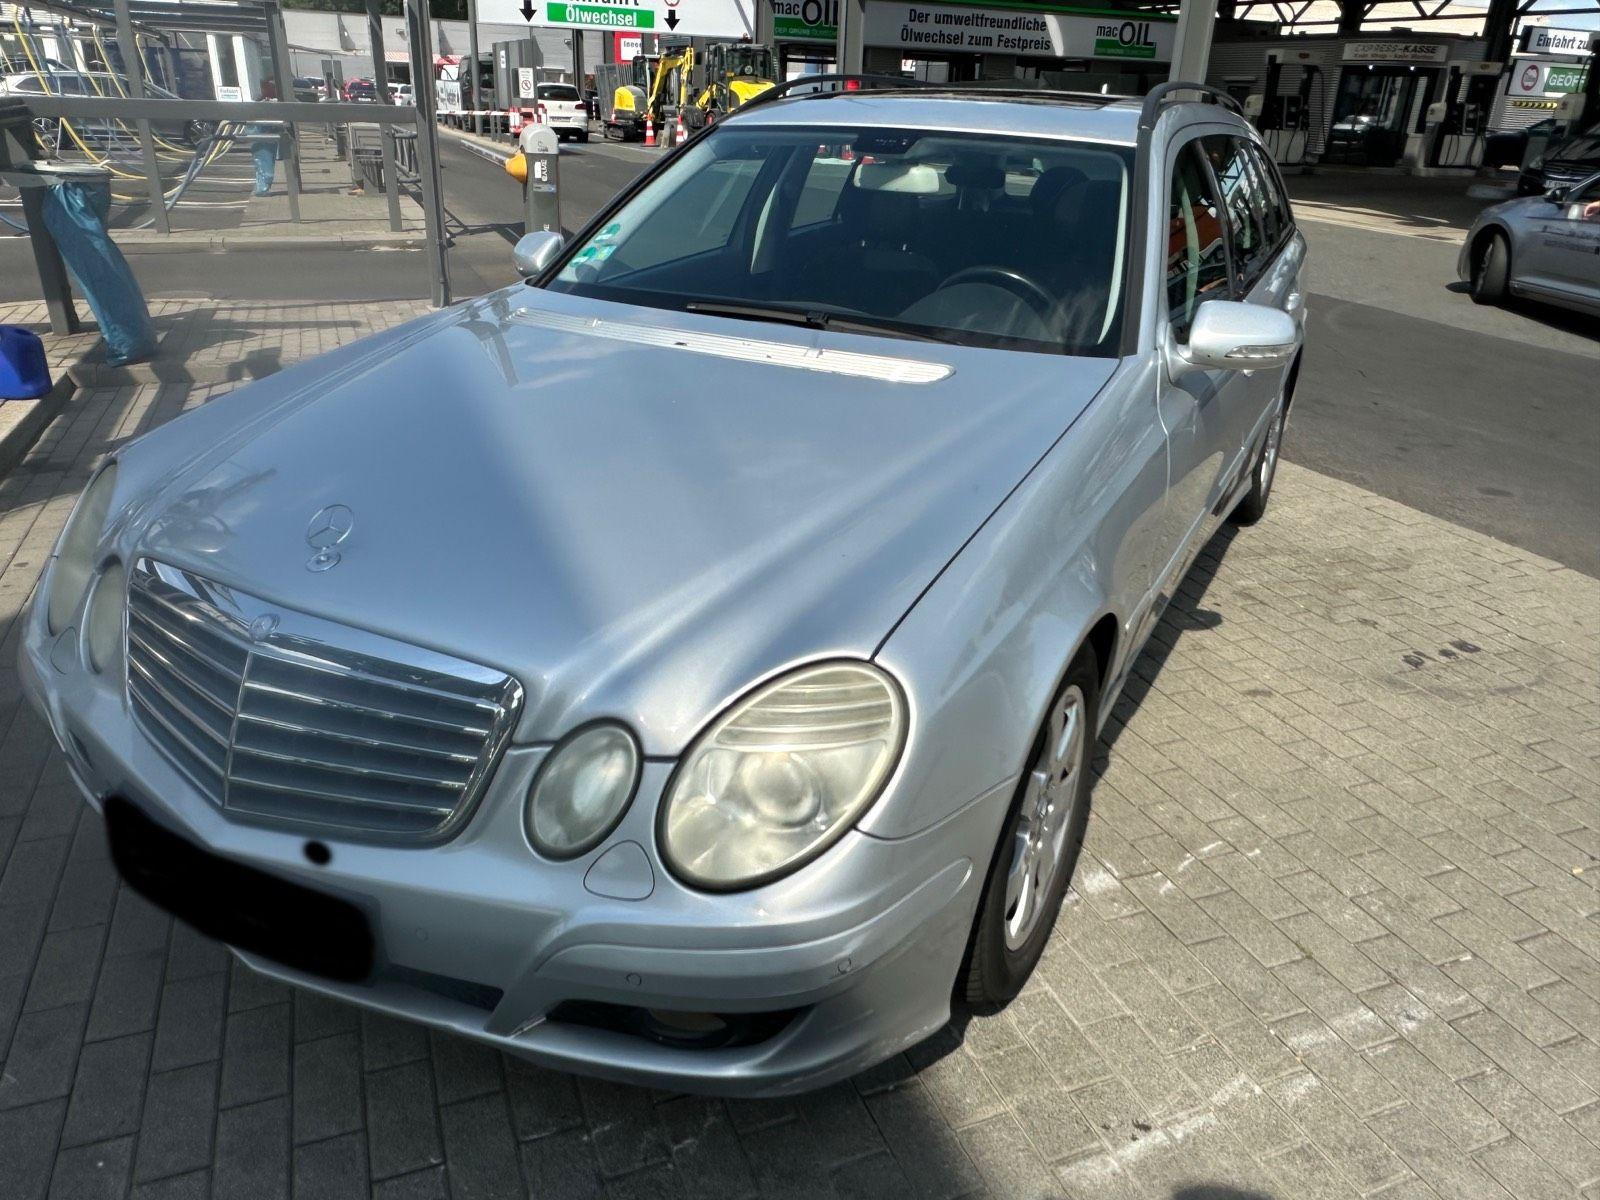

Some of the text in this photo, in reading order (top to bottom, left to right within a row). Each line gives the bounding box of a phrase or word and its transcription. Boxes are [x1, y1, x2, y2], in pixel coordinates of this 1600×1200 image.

[565, 4, 638, 27] Ölwechsel
[909, 8, 1047, 32] Der umweltfreundliche
[900, 24, 1052, 52] Ölwechsel zum Festpreis
[1096, 21, 1157, 46] macOIL
[1536, 34, 1576, 50] Einfahrt
